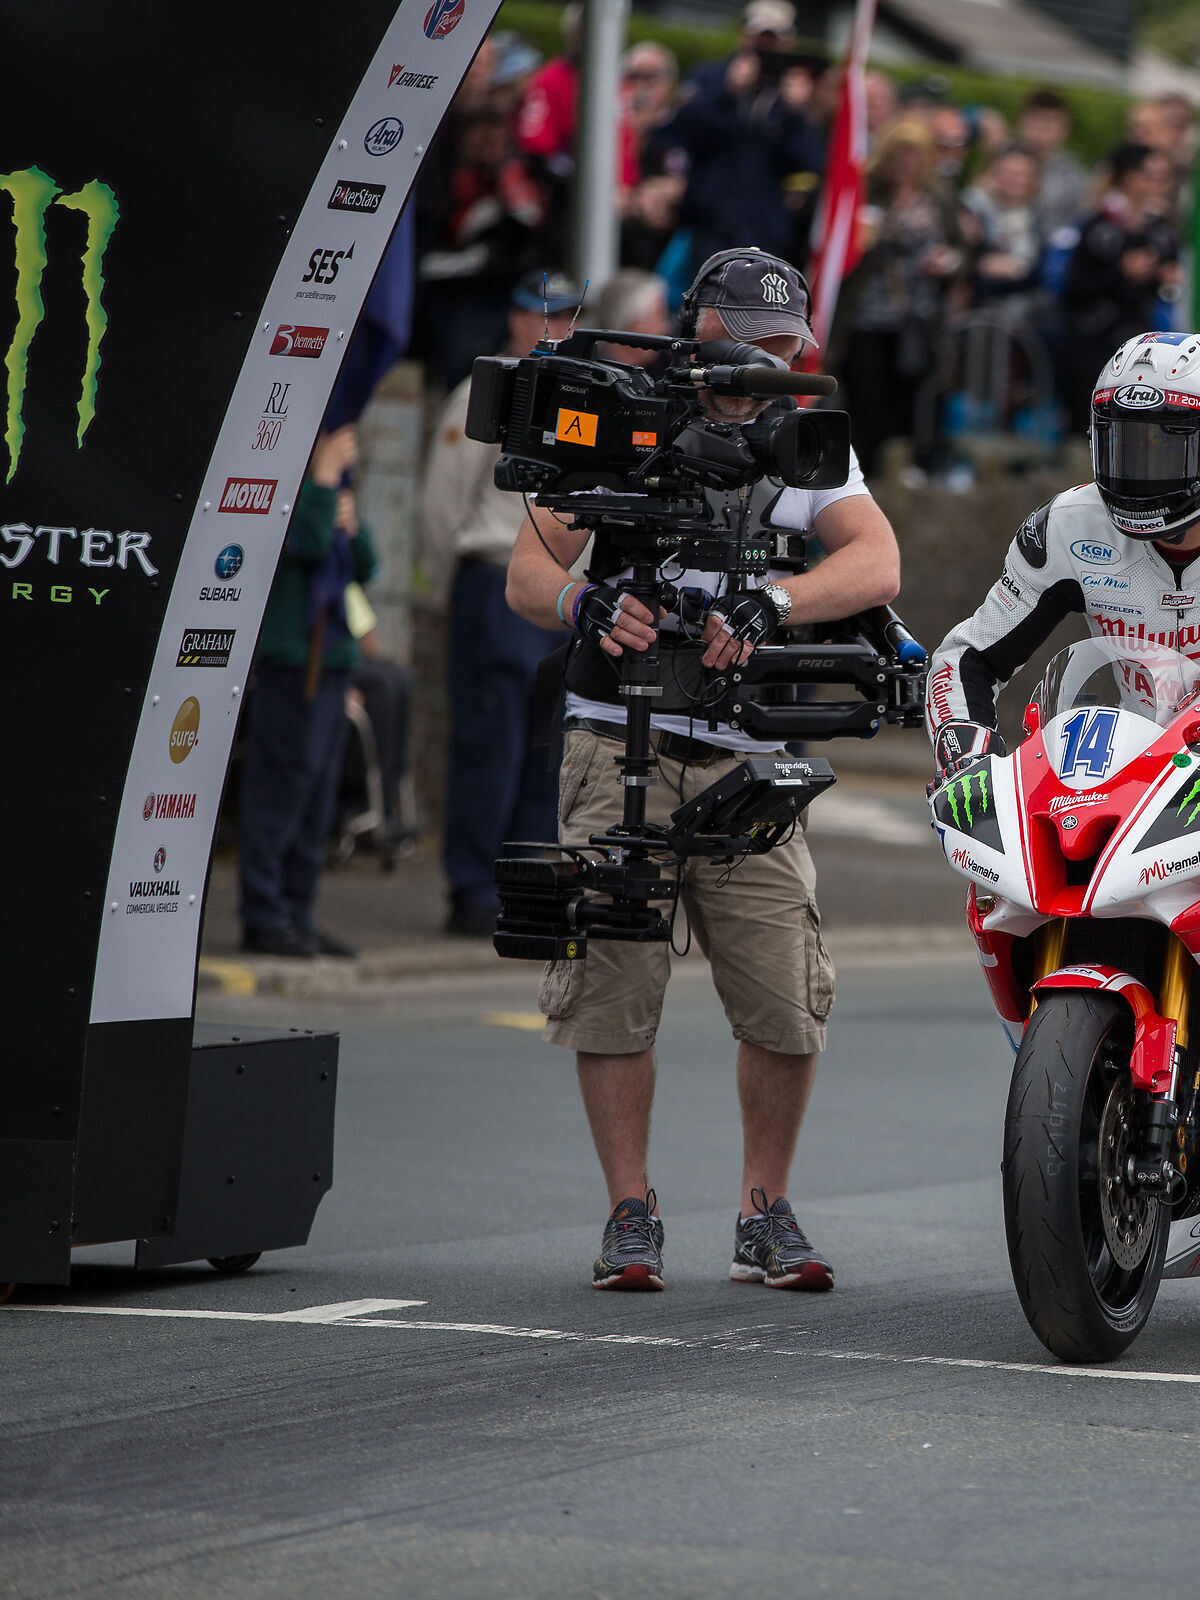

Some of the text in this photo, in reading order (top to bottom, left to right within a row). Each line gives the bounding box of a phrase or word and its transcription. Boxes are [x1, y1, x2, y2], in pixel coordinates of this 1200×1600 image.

[396, 72, 439, 89] DAINESE
[366, 121, 401, 146] Arai
[302, 248, 346, 284] SES
[760, 273, 790, 304] NY
[293, 332, 325, 350] bennetts
[263, 382, 292, 415] RL
[1117, 385, 1159, 401] Arai
[1168, 394, 1179, 402] TT
[251, 420, 282, 450] 360
[564, 415, 582, 438] A
[221, 482, 274, 510] MOTUL
[0, 522, 159, 577] STER
[1080, 543, 1113, 559] KGN
[12, 582, 110, 605] RGY
[1082, 575, 1129, 590] Cool Milk
[199, 587, 242, 601] SUBARU
[1090, 602, 1135, 615] METZELER
[181, 632, 234, 654] GRAHAM
[797, 658, 837, 668] PRO
[945, 729, 962, 754] RST
[1059, 709, 1121, 780] 14
[154, 793, 197, 819] YAMAHA
[1048, 791, 1110, 813] Milwaukee
[129, 880, 180, 898] VAUXHALL
[126, 902, 179, 915] COMMERCIAL VEHICLES
